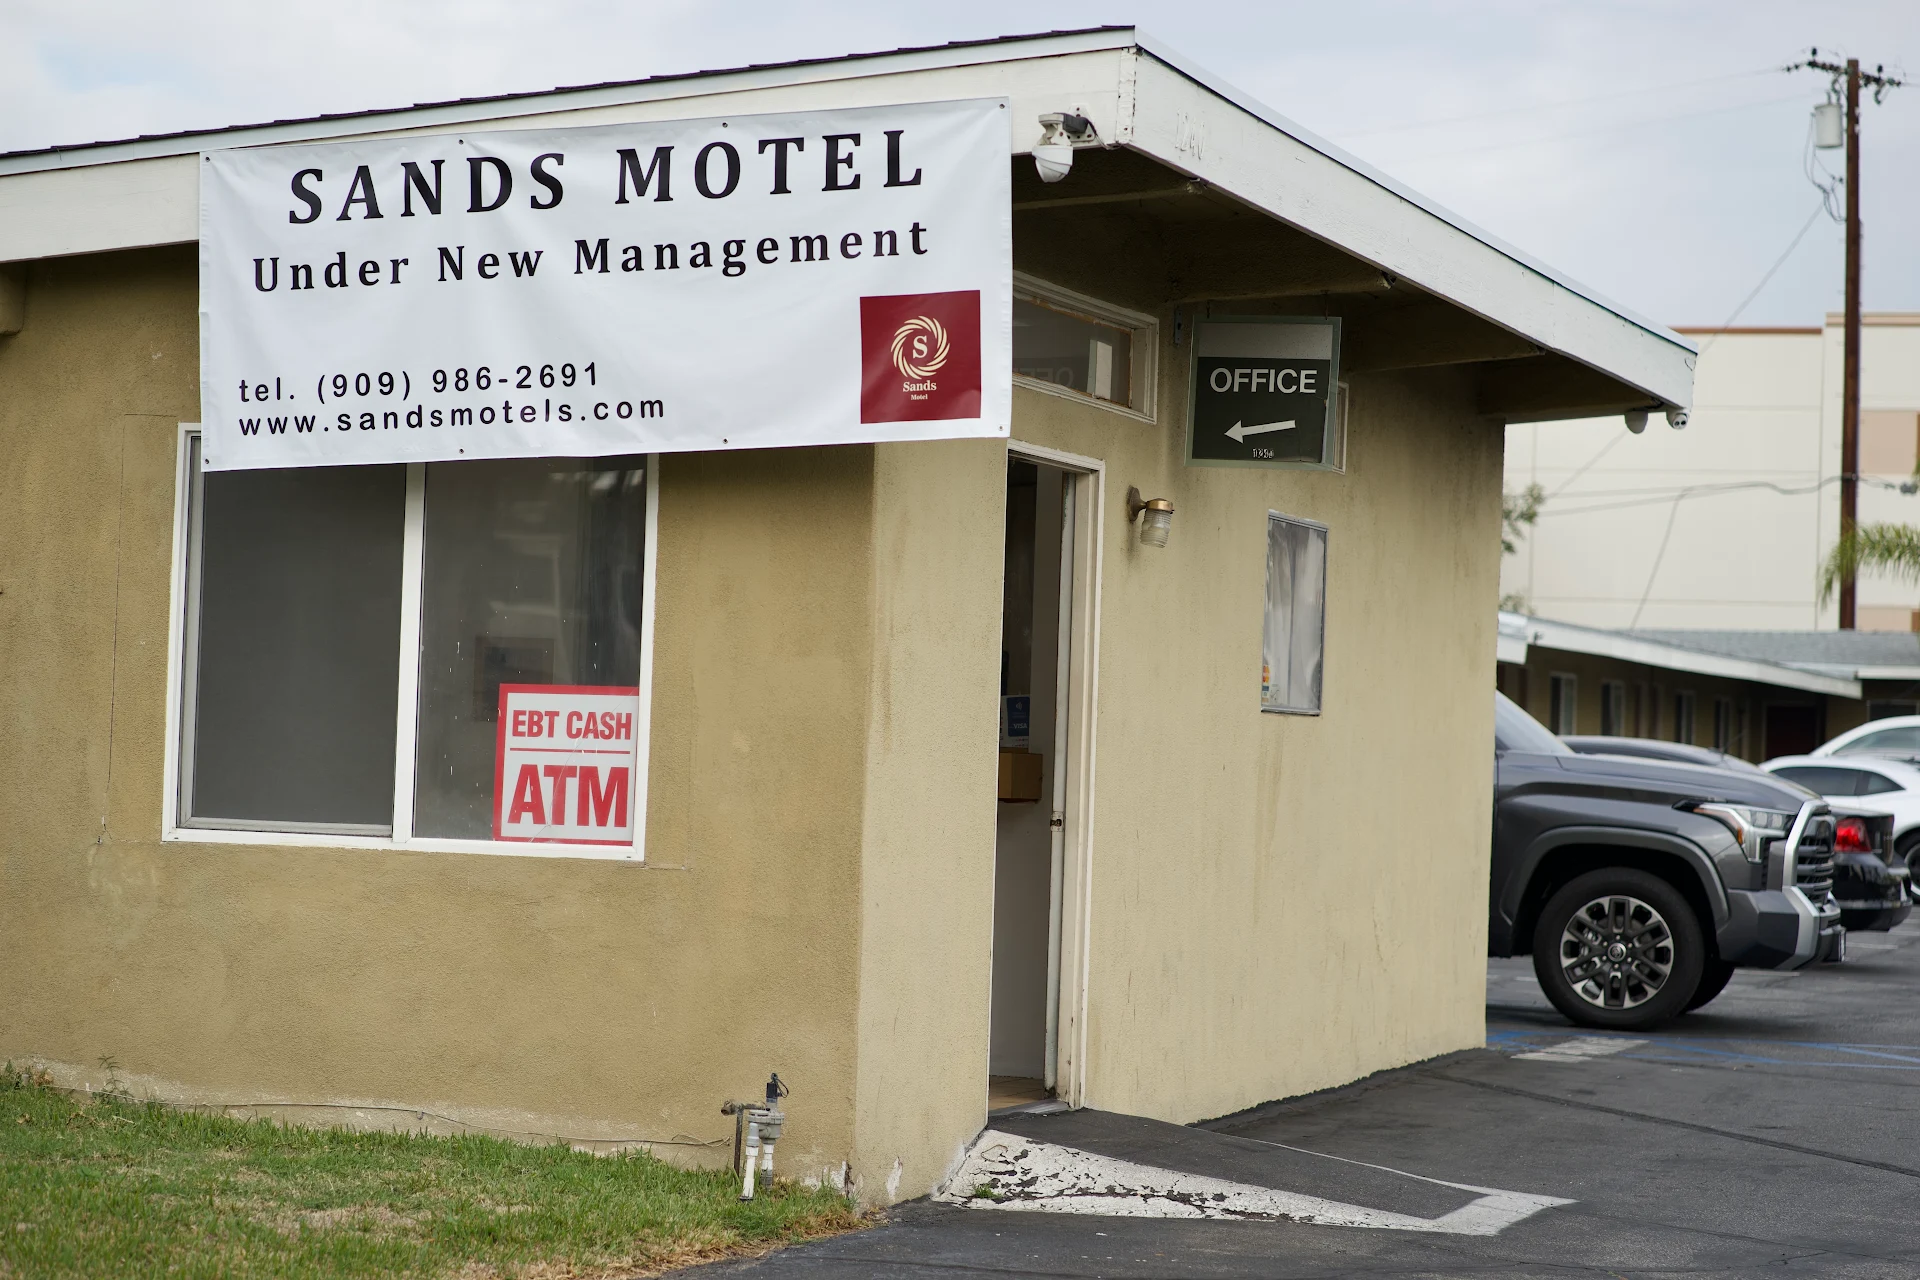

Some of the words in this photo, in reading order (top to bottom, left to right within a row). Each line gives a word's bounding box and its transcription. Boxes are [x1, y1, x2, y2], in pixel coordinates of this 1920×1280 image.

[290, 153, 564, 224] SANDS
[615, 130, 921, 204] MOTEL
[253, 252, 408, 292] Under
[438, 246, 543, 281] New
[574, 223, 928, 278] Management
[913, 335, 928, 358] S
[239, 377, 295, 403] tel.
[318, 371, 410, 404] (909)
[433, 362, 595, 392] 986-2691
[902, 380, 937, 392] Sands
[1210, 367, 1318, 394] OFFICE
[239, 399, 663, 436] www.sandsmotels.com
[512, 710, 560, 738] EBT
[566, 710, 632, 740] CASH
[507, 764, 629, 827] ATM
